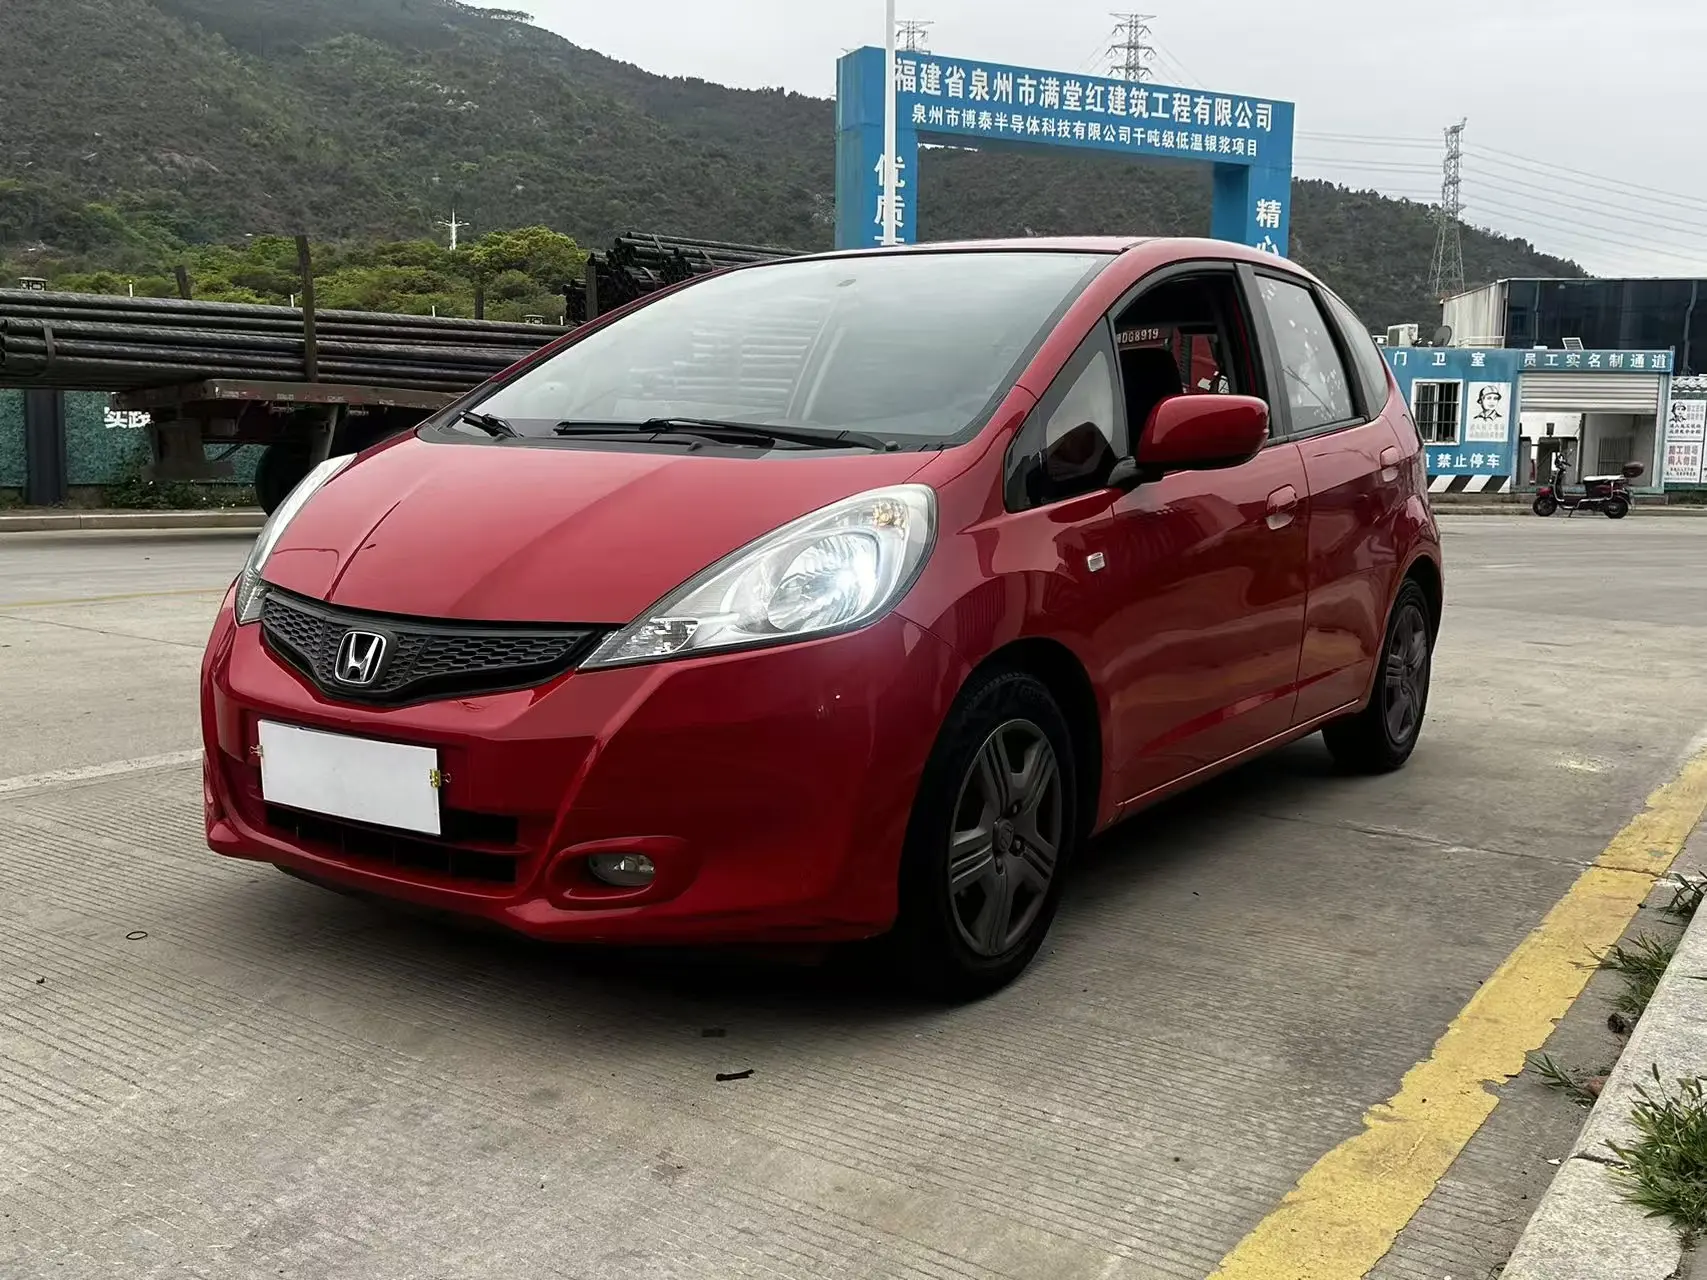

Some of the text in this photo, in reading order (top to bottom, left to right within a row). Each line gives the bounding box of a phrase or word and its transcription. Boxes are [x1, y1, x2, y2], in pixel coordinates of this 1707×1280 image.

[895, 58, 1273, 132] 福建省泉州市满堂红建筑工程有限公司
[911, 103, 1257, 157] 泉州市博泰半导体科技有限公司千吨级低温银浆项目
[874, 153, 906, 246] 优质
[1394, 351, 1486, 367] 门卫室
[1524, 353, 1667, 368] 员工实名制通道
